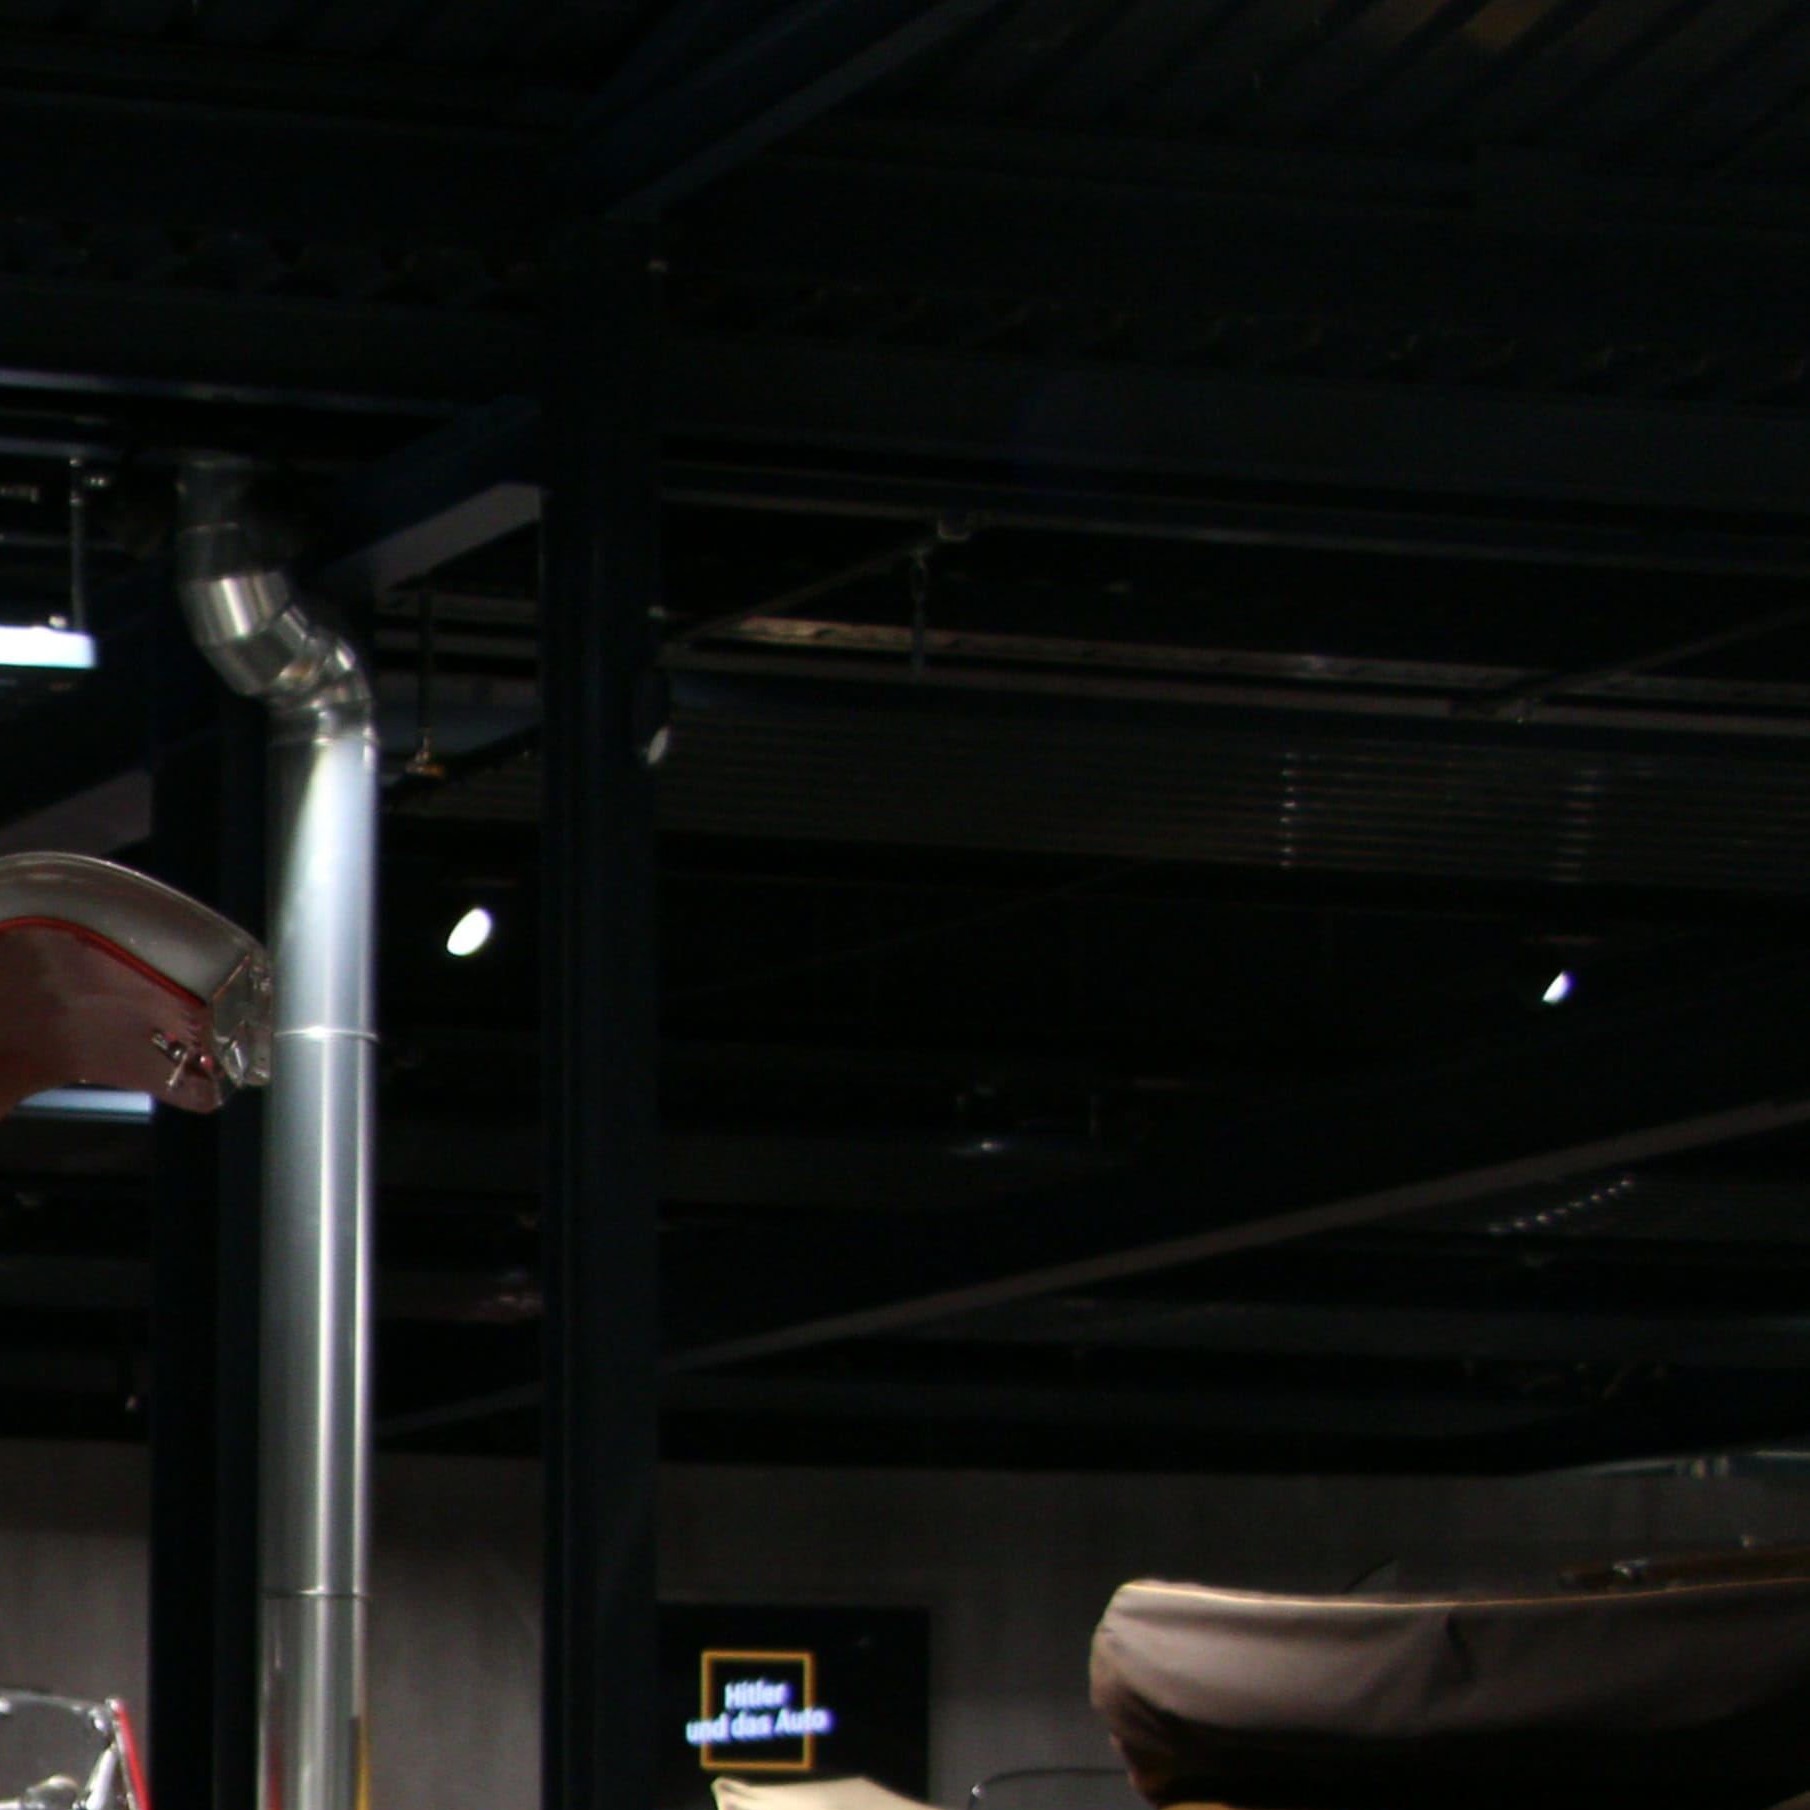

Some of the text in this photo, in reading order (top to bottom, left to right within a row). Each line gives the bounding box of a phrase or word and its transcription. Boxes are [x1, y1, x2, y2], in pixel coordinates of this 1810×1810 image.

[724, 1677, 793, 1709] Hitler
[685, 1705, 834, 1745] und das Auto
